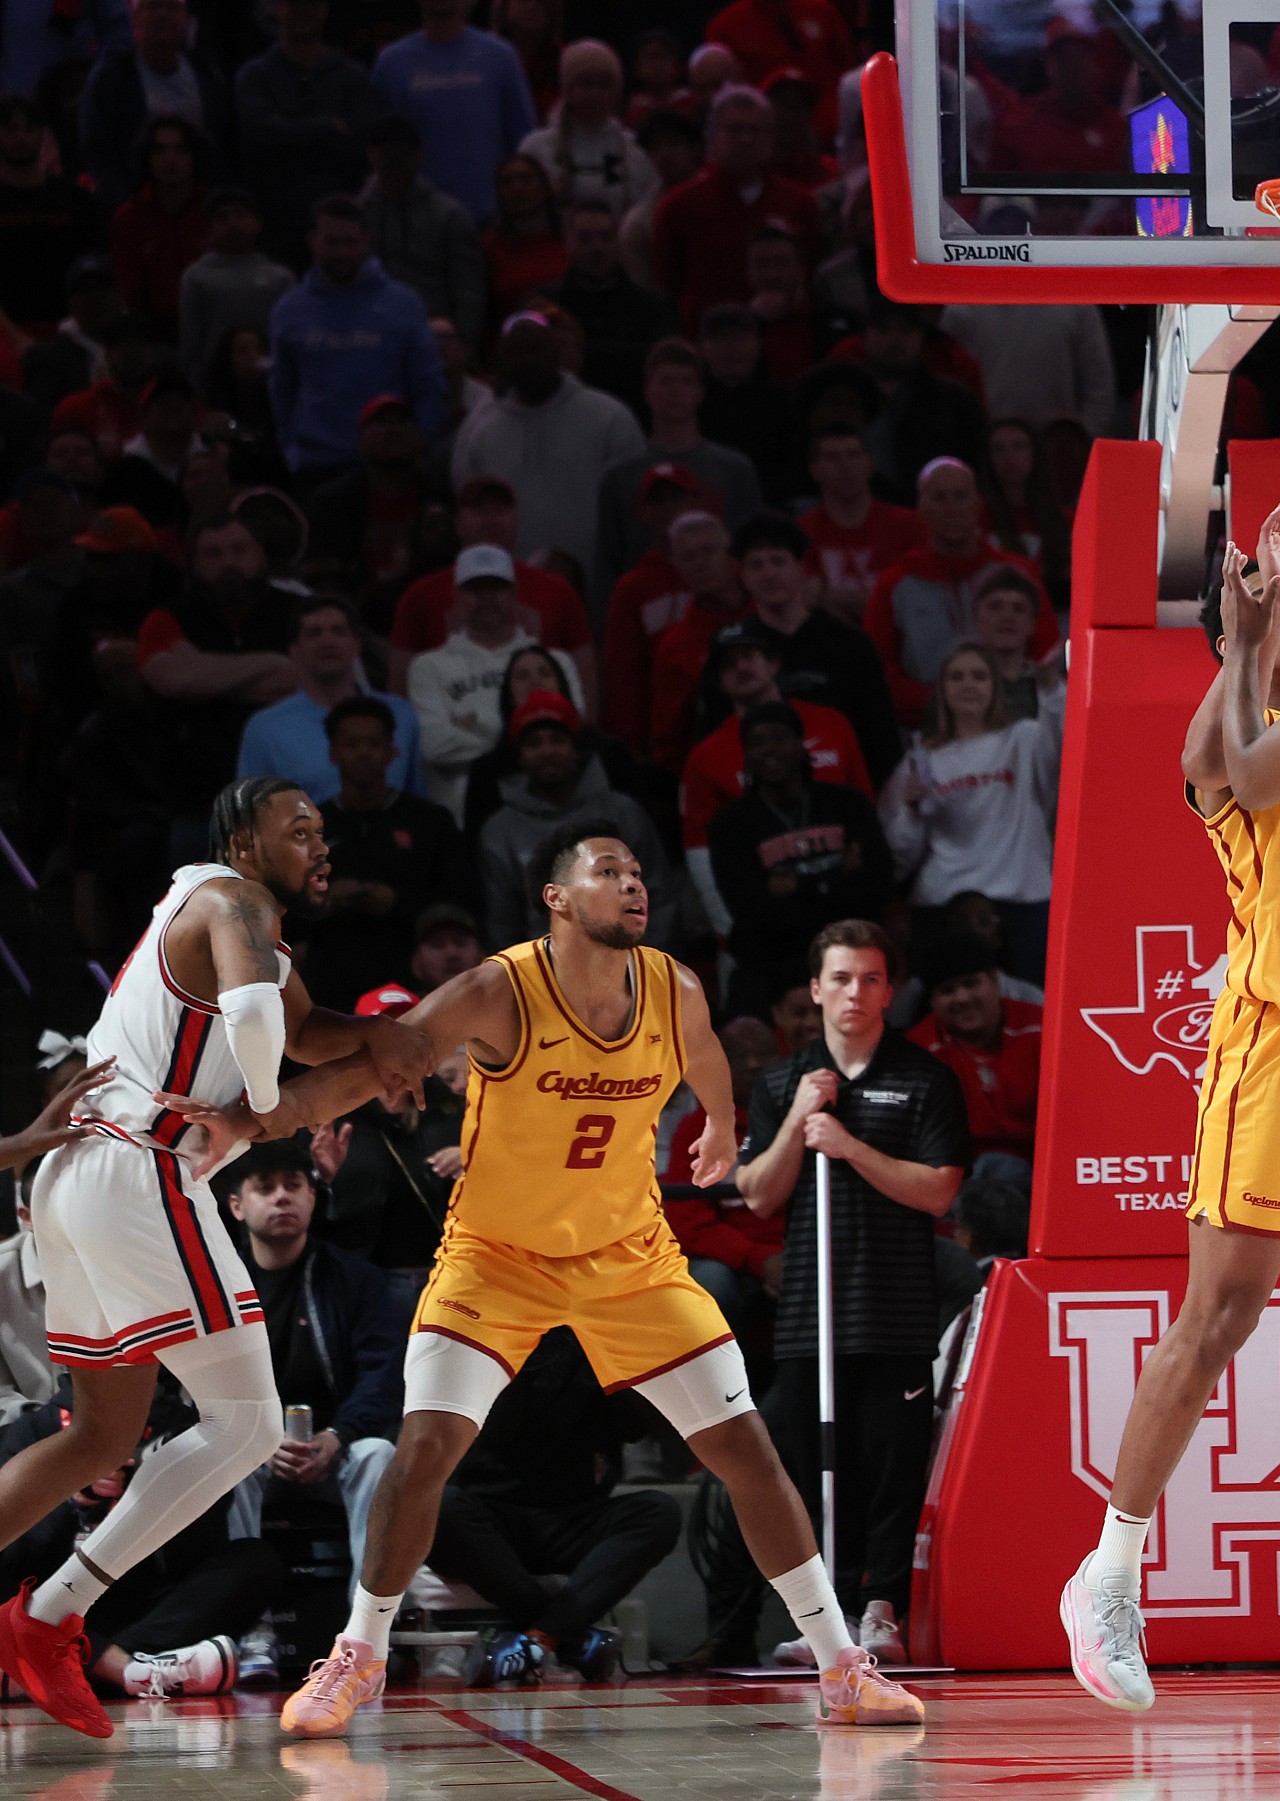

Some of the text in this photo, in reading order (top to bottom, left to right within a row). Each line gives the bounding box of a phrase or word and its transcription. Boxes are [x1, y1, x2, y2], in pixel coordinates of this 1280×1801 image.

[944, 244, 1030, 263] SPALDING
[536, 1070, 663, 1101] Cyclones
[565, 1114, 616, 1169] 2
[1075, 1154, 1194, 1185] BEST I
[1114, 1192, 1189, 1211] TEXAS
